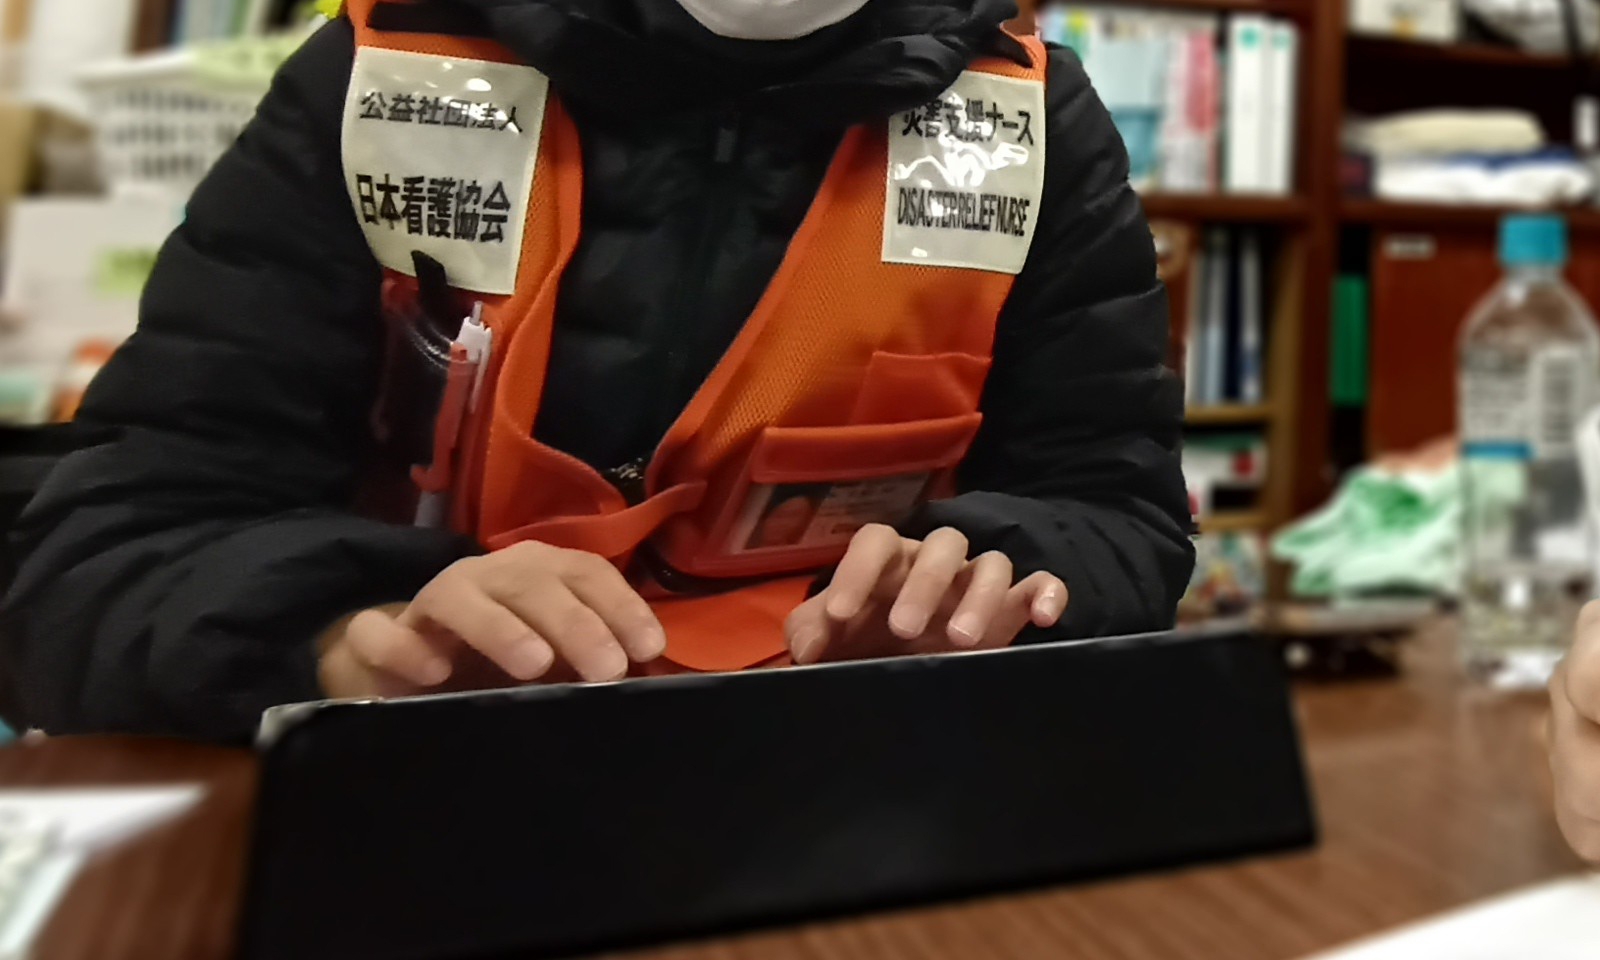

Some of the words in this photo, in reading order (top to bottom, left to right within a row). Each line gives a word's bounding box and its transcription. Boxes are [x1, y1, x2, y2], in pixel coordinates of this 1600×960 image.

[360, 92, 523, 133] 公益社団法人
[356, 173, 511, 243] 日本看護協会
